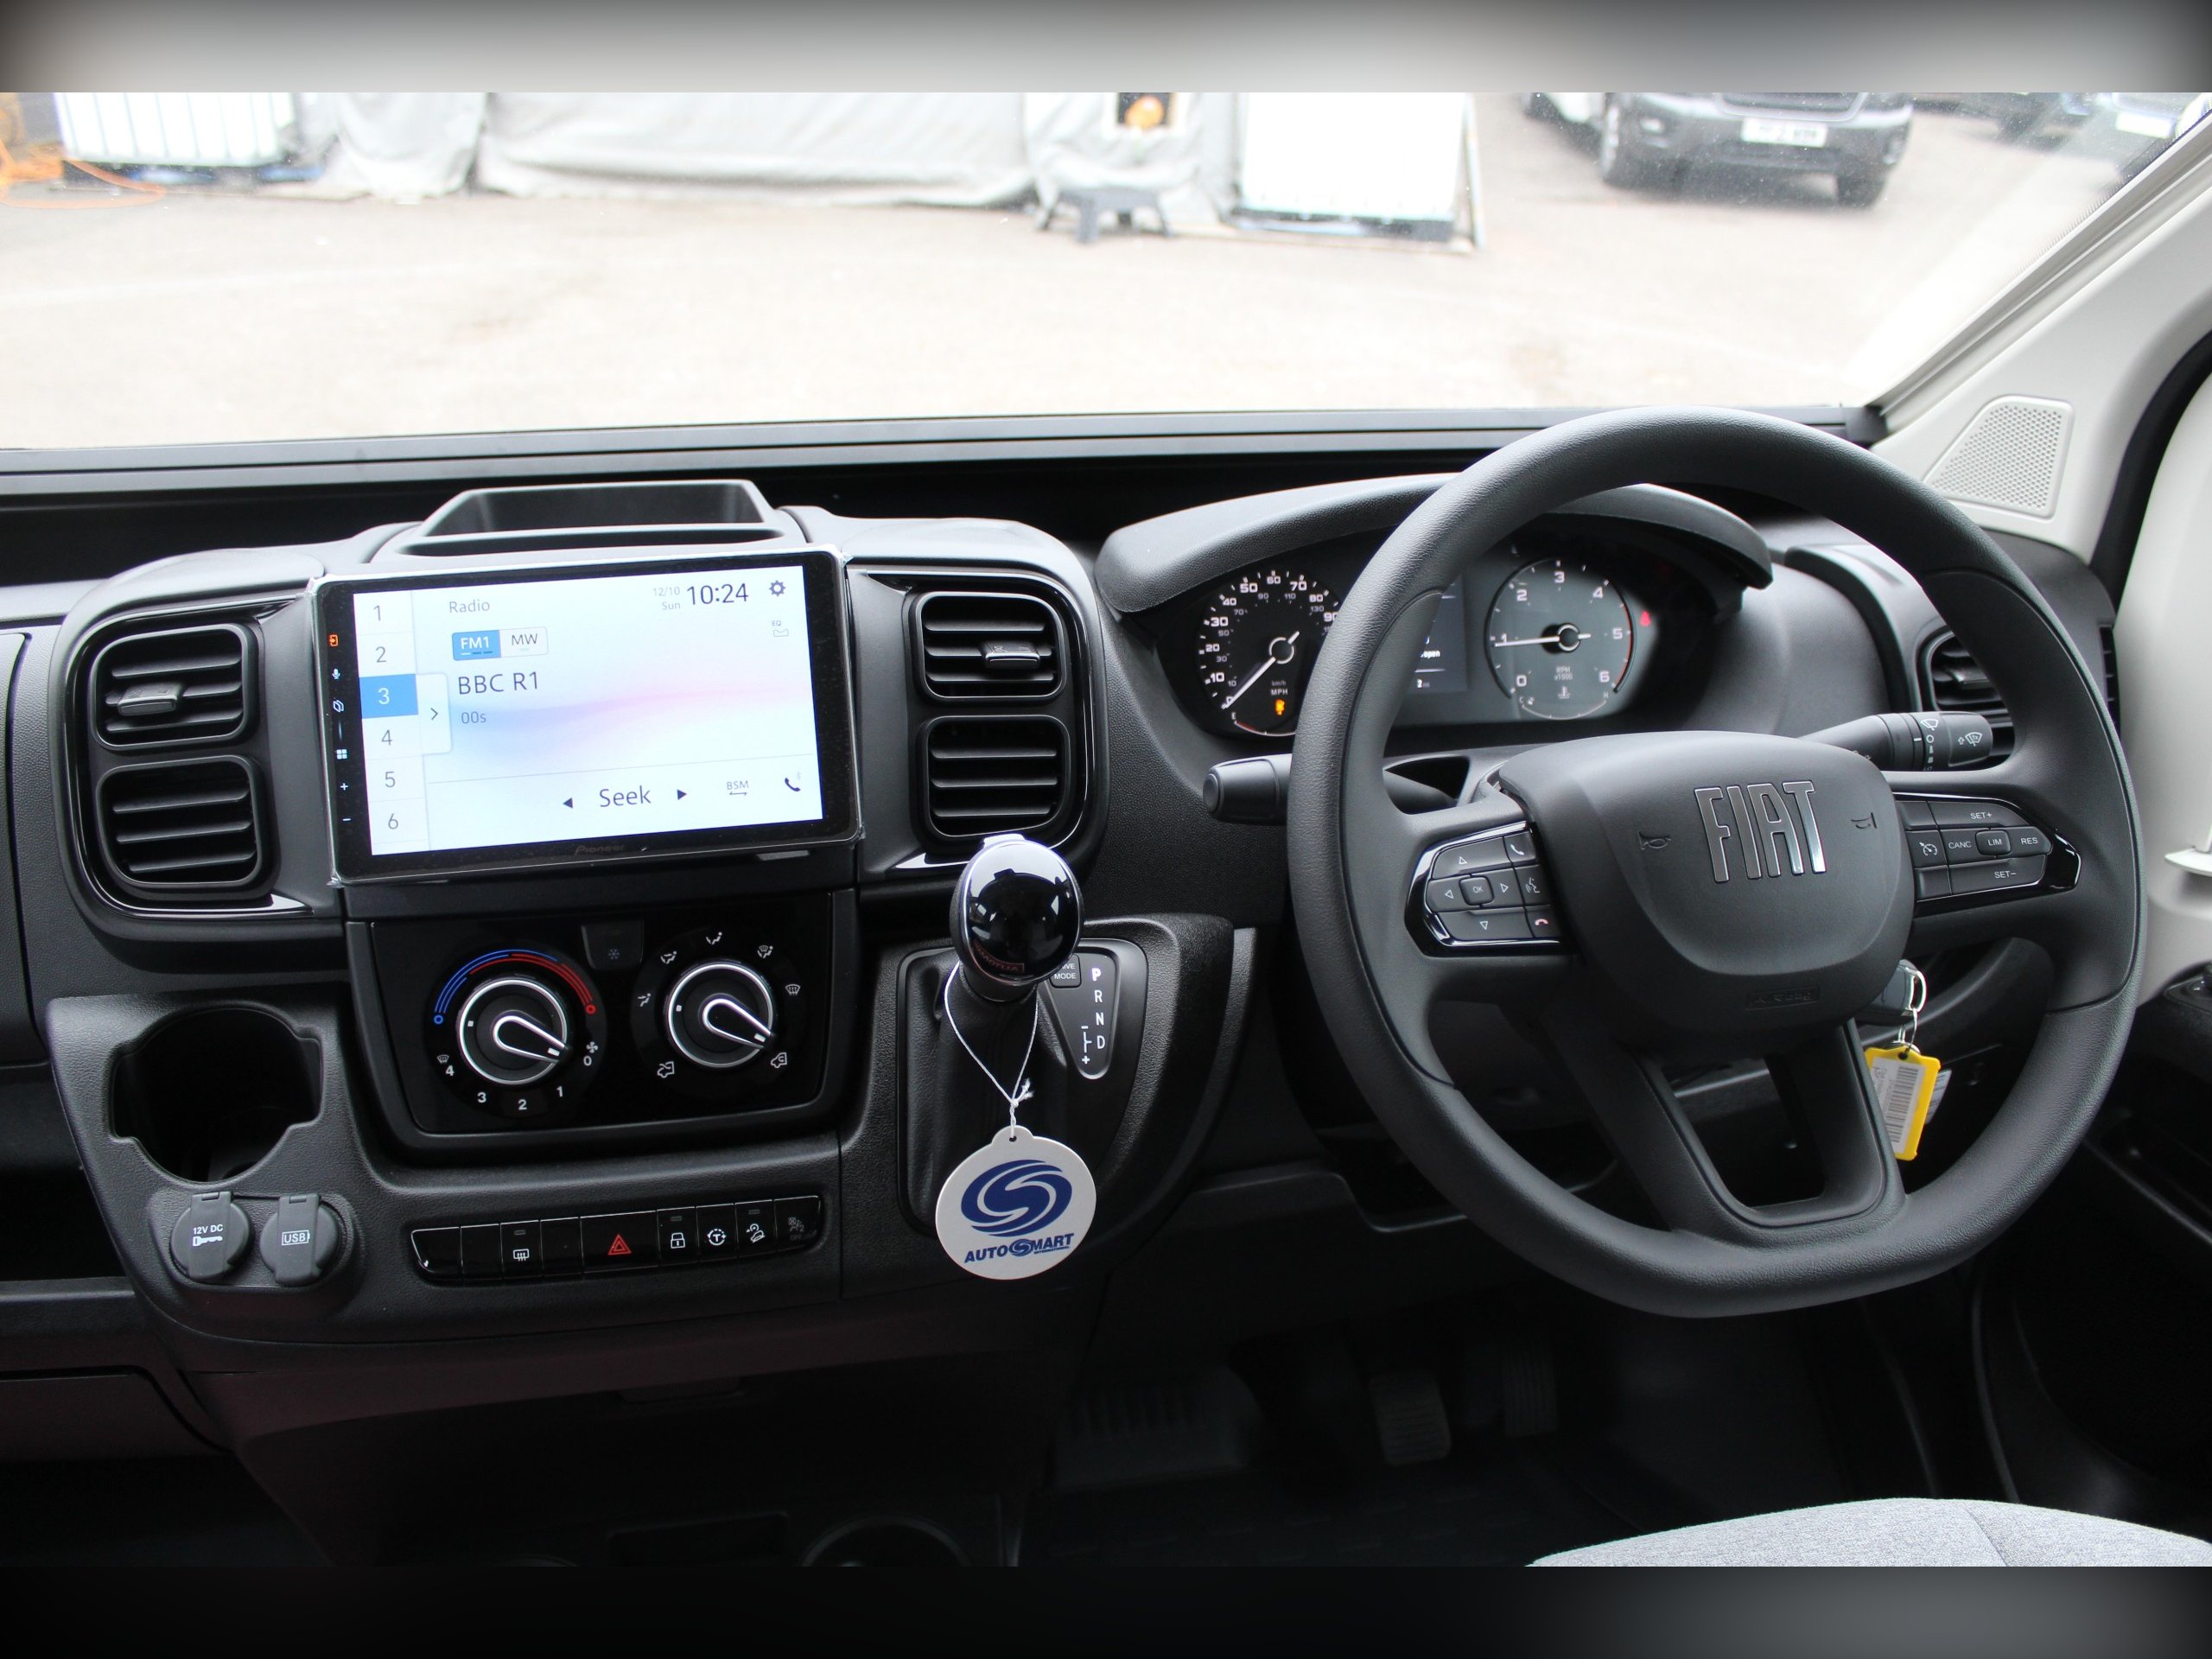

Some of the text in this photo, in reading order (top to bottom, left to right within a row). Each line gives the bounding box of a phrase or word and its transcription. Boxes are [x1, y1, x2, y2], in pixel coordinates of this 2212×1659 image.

[1266, 575, 1281, 584] 60
[1554, 571, 1566, 583] 3
[653, 587, 681, 597] 12/10
[1240, 583, 1258, 593] 50
[1290, 581, 1307, 591] 70
[686, 582, 749, 606] 10:24
[1309, 594, 1324, 602] 80
[1516, 589, 1528, 601] 2
[1592, 587, 1604, 599] 4
[448, 599, 491, 613] Radio
[662, 601, 681, 611] Sun
[373, 605, 381, 621] 1
[1211, 616, 1229, 626] 30
[511, 632, 538, 646] MW
[1500, 633, 1508, 644] 1
[1612, 627, 1623, 639] 5
[461, 636, 490, 650] FM1
[1205, 644, 1220, 652] 20
[375, 646, 387, 664] 2
[458, 671, 538, 695] BBC R1
[1210, 672, 1224, 683] 10
[1516, 675, 1528, 687] 0
[1599, 671, 1610, 683] 6
[378, 688, 391, 705] 3
[461, 711, 486, 725] 00s
[381, 729, 393, 746] 4
[385, 771, 396, 788] 5
[726, 779, 750, 791] BSM
[599, 785, 652, 808] Seek
[388, 813, 399, 830] 6
[1694, 780, 1827, 883] FIAT
[1948, 841, 1972, 849] CANC
[2020, 836, 2038, 845] RES
[1091, 968, 1102, 982] P
[1094, 989, 1103, 1003] R
[1096, 1012, 1104, 1026] N
[1096, 1035, 1105, 1049] D
[583, 1056, 592, 1066] 0
[445, 1065, 454, 1077] 4
[477, 1091, 486, 1103] 3
[556, 1085, 563, 1097] 1
[518, 1099, 527, 1110] 2
[193, 1224, 224, 1235] 12V DC
[283, 1232, 306, 1244] USB
